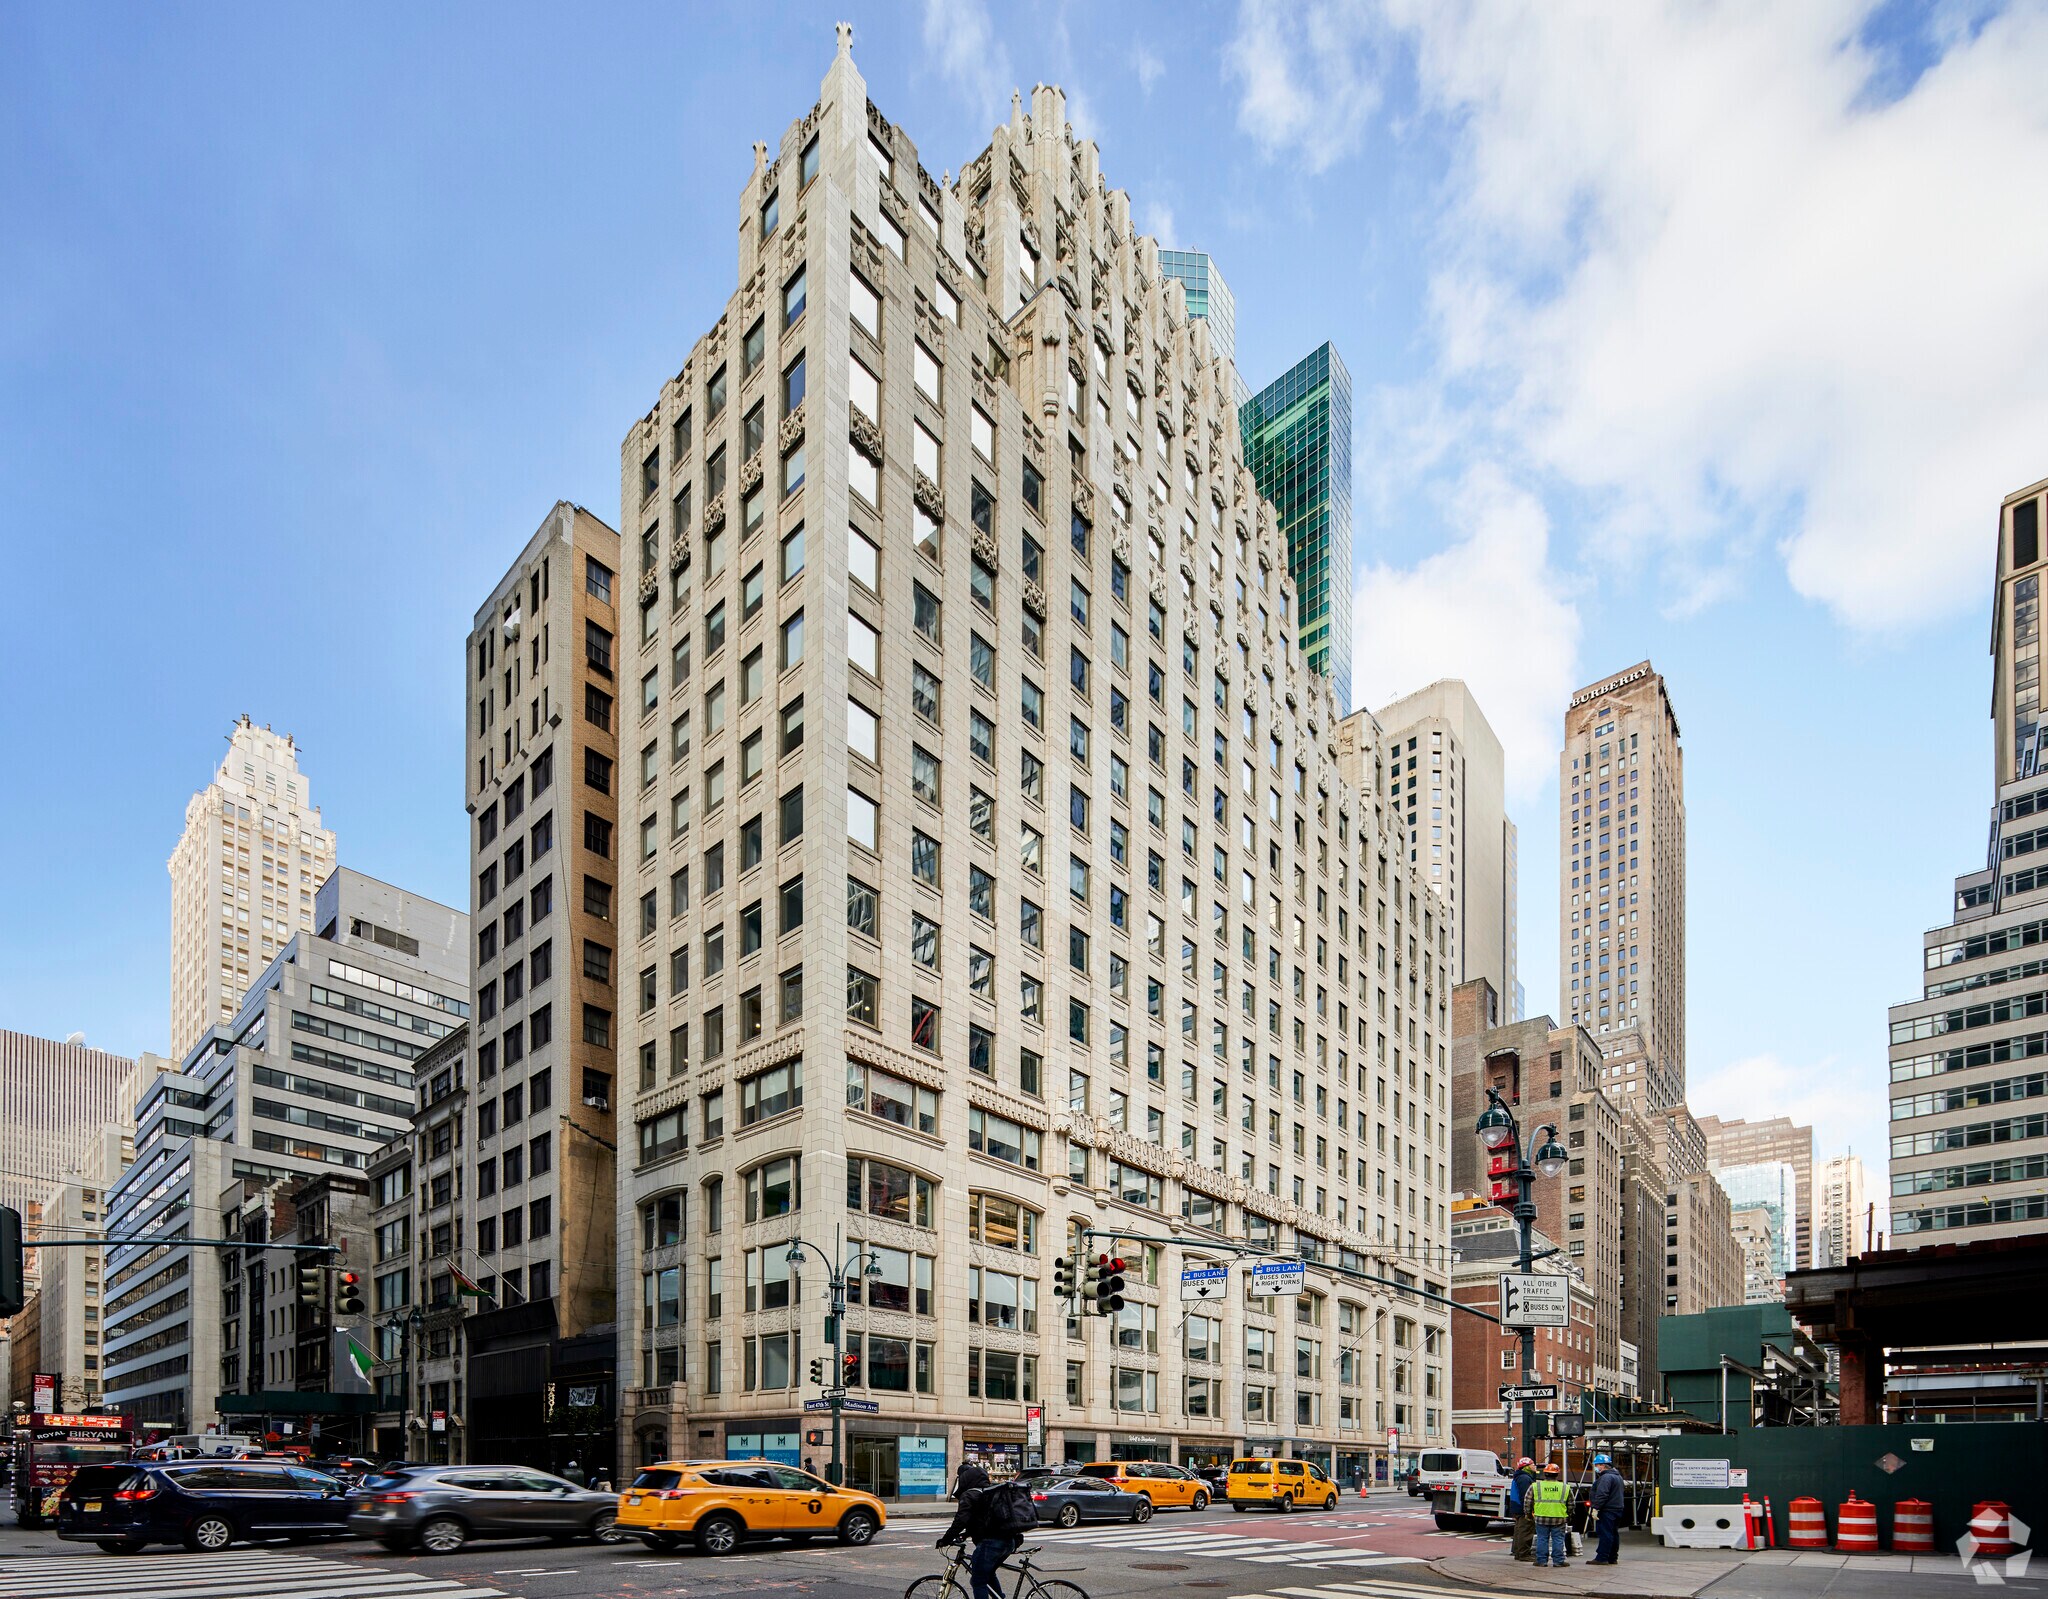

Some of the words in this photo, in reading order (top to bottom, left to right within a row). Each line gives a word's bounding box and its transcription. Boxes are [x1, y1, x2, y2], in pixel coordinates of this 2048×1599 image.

[1572, 667, 1649, 708] BURBERRY
[844, 1401, 867, 1409] Madison
[36, 1430, 66, 1439] ROYAL
[69, 1430, 117, 1439] BIRYANI
[811, 1502, 819, 1513] T
